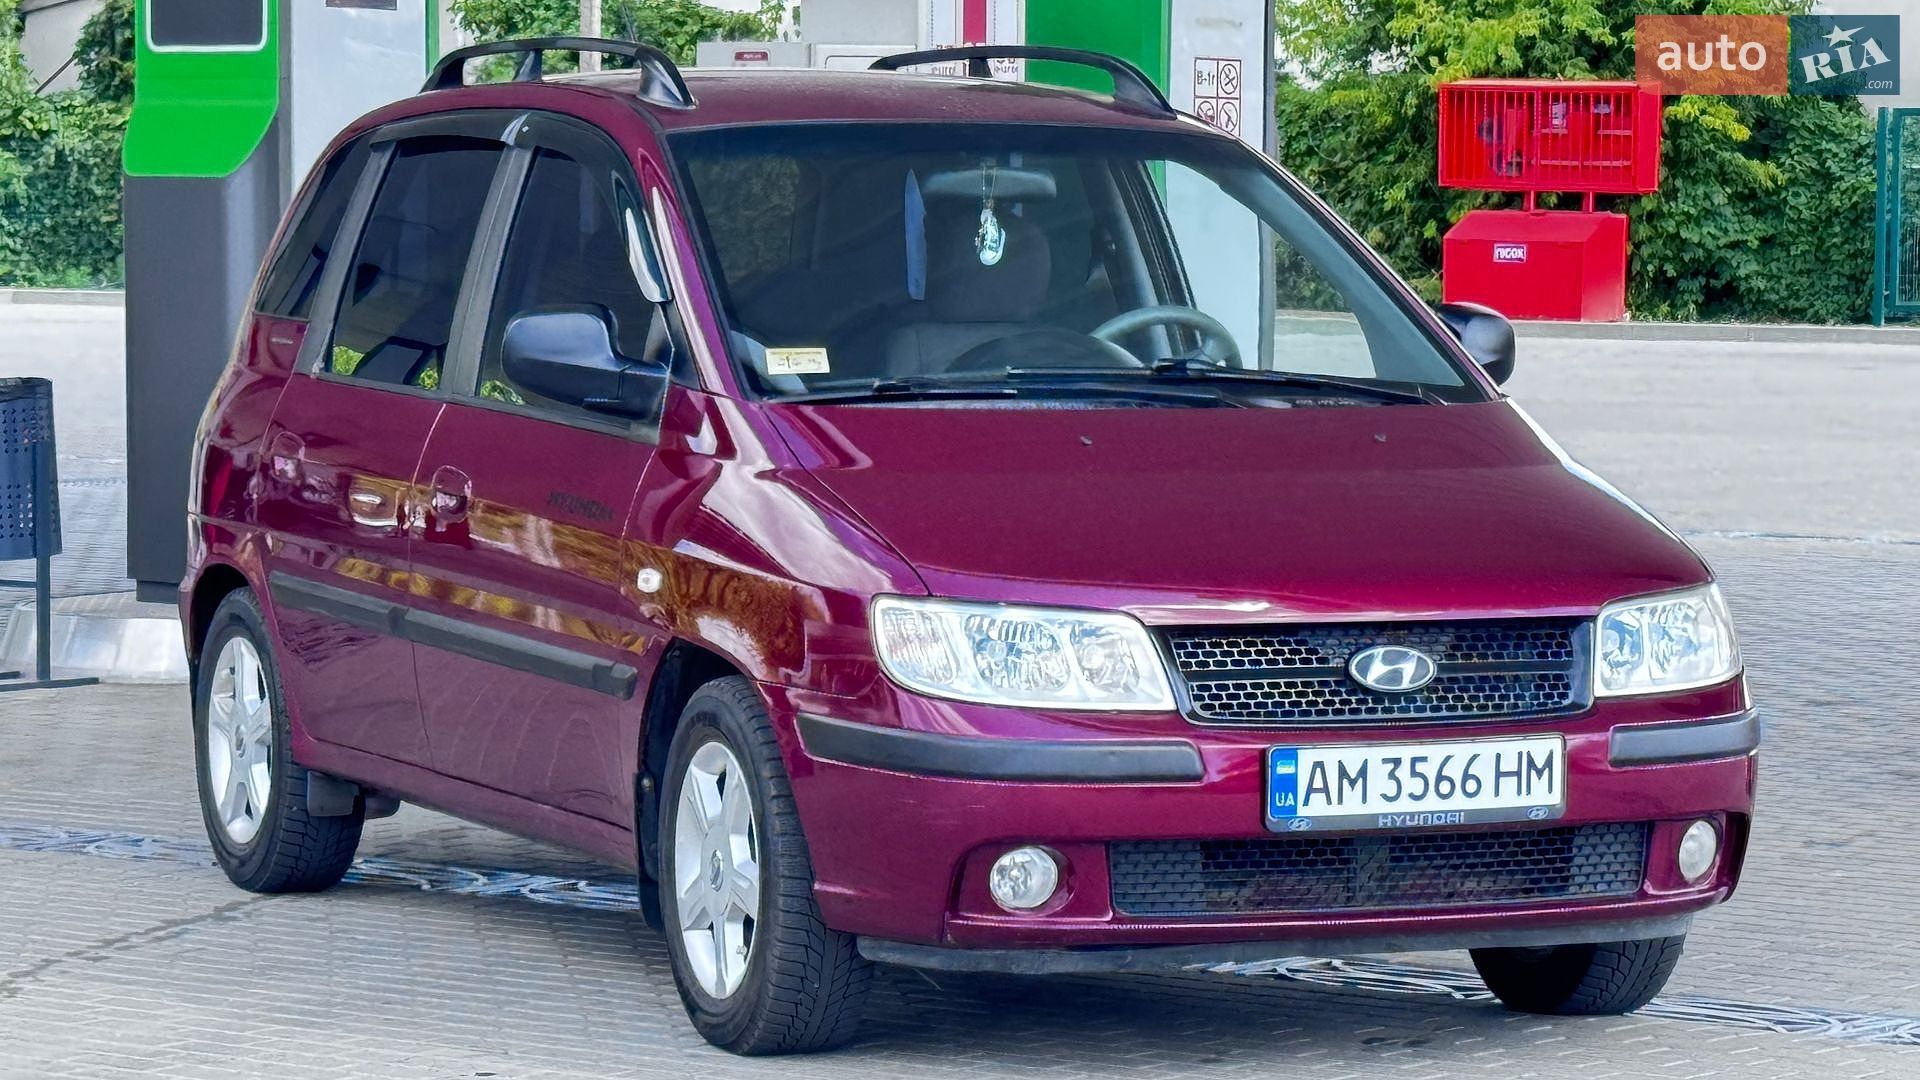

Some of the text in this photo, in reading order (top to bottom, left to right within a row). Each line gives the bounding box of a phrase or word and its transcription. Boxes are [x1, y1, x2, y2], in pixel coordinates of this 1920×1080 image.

[1379, 753, 1482, 803] 3566
[1275, 792, 1295, 807] UA
[1378, 811, 1465, 828] HYUNDAI
